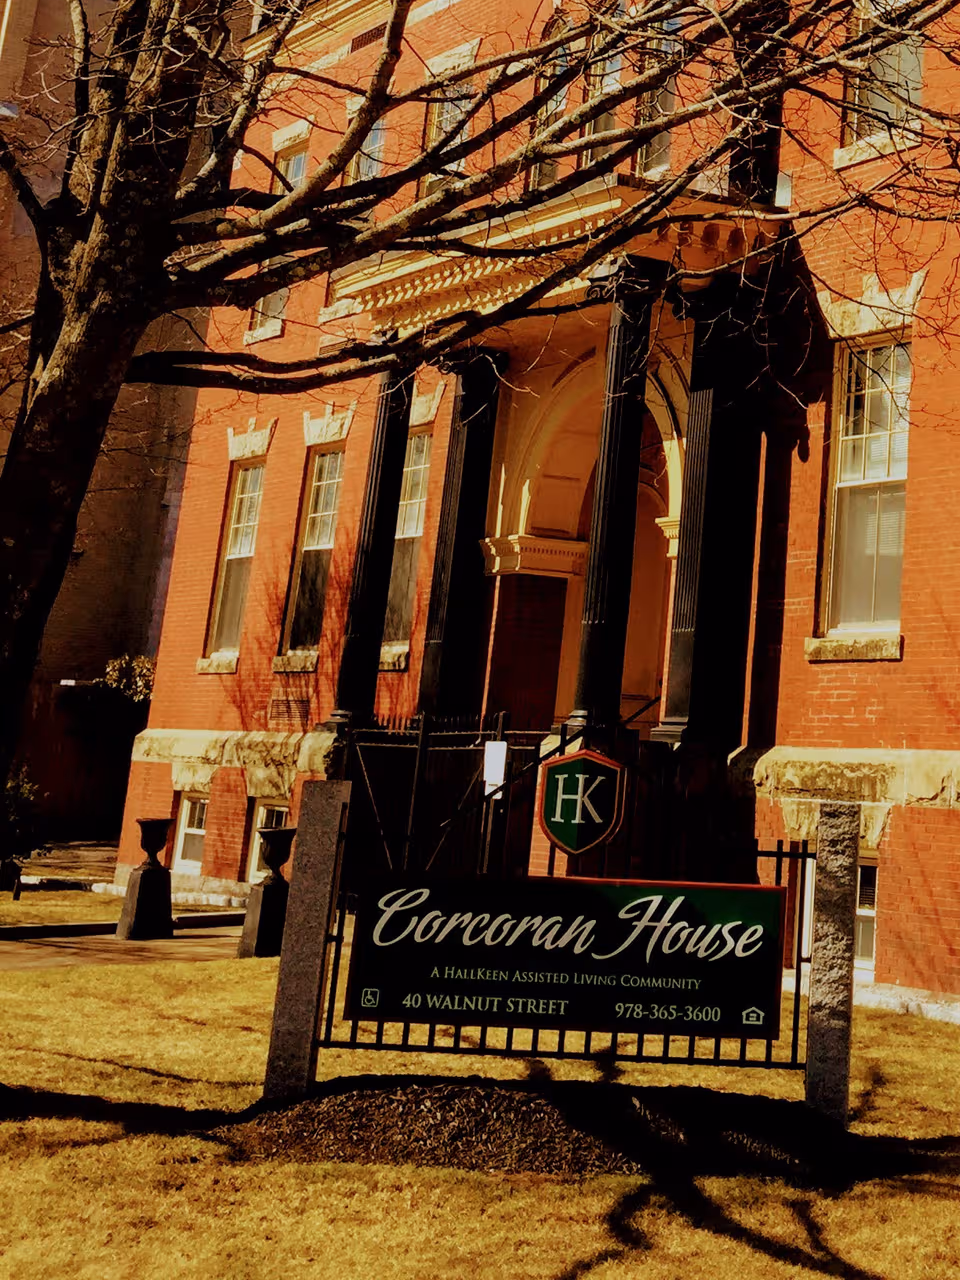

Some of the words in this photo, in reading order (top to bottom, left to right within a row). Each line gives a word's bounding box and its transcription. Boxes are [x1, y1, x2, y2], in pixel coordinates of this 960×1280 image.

[551, 773, 606, 824] HK
[372, 888, 597, 955] Corcoran
[591, 895, 764, 964] House
[430, 966, 440, 979] A
[512, 970, 570, 985] ASSISTED
[573, 972, 617, 987] LIVING
[620, 974, 702, 990] COMMUNITY
[402, 993, 422, 1009] 40
[426, 994, 502, 1013] WALNUT
[506, 997, 569, 1015] STREET
[615, 1002, 721, 1022] 978-365-3600
